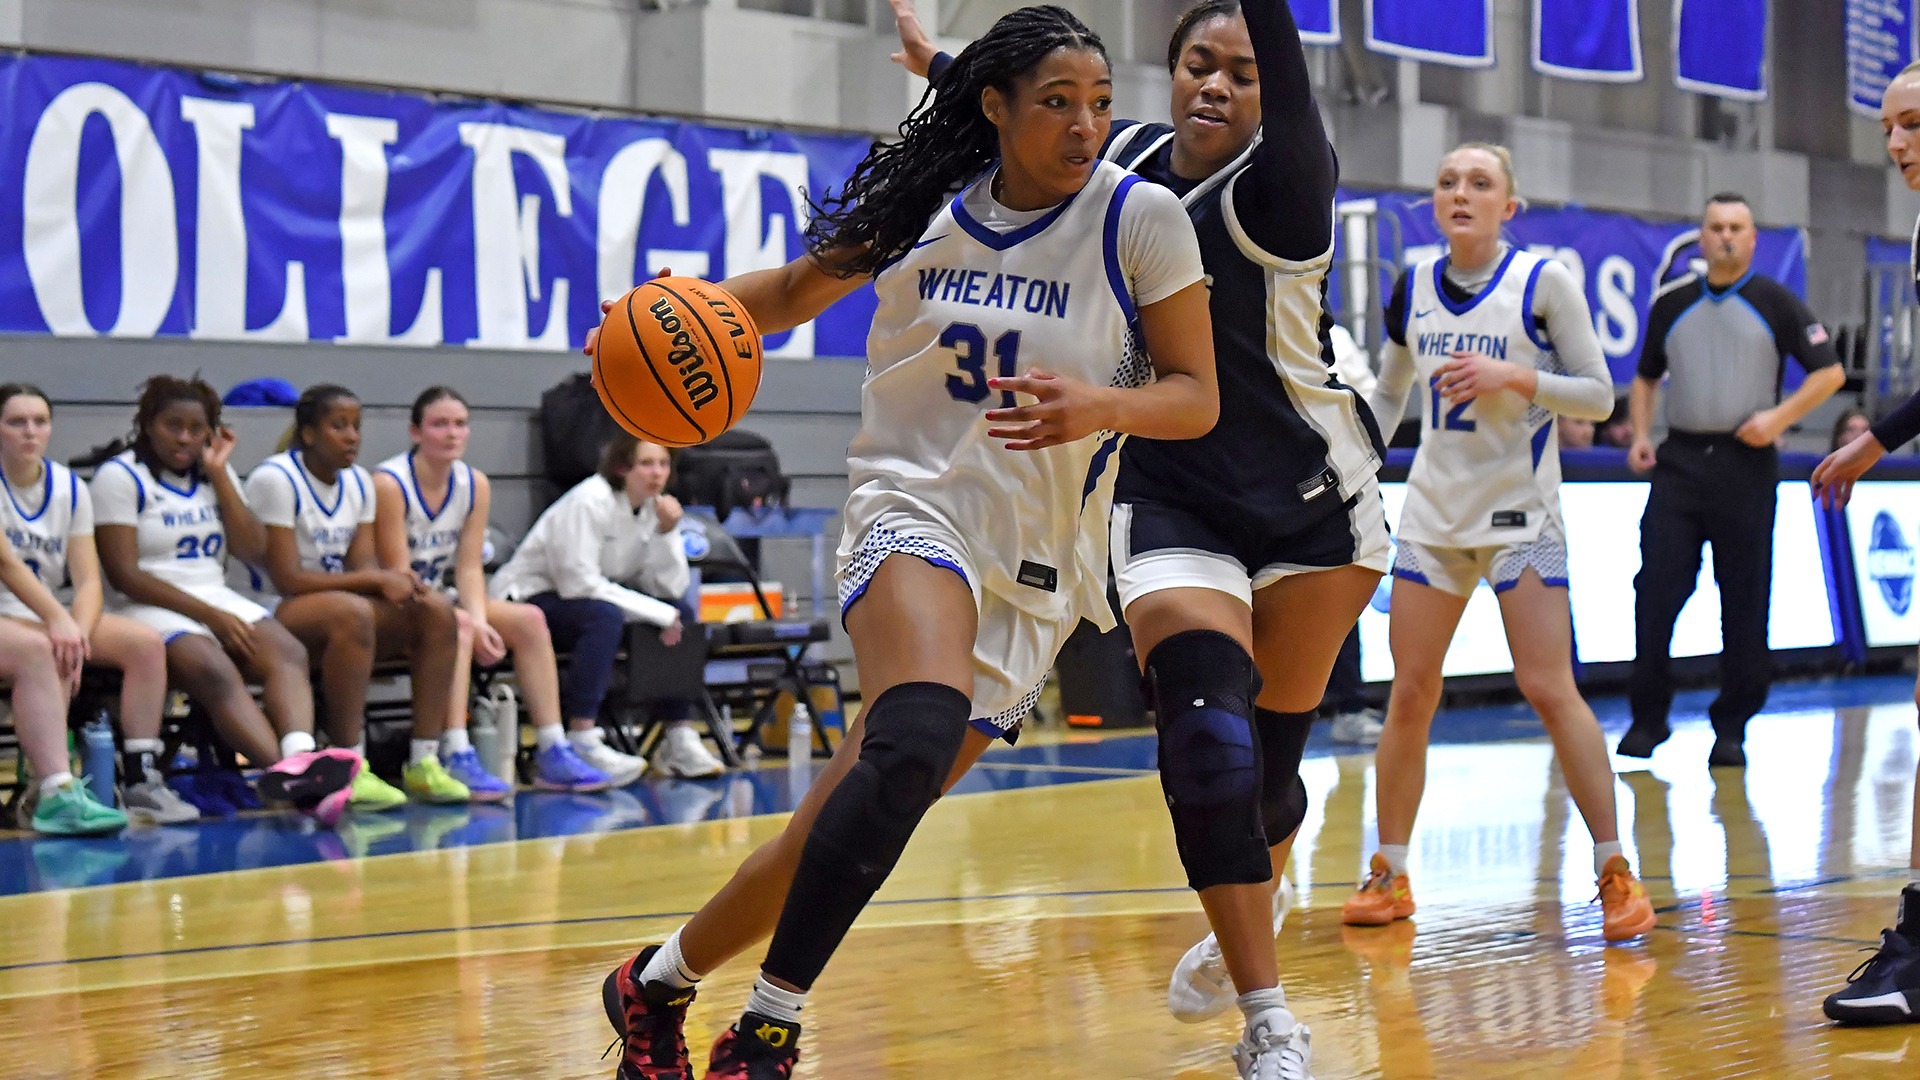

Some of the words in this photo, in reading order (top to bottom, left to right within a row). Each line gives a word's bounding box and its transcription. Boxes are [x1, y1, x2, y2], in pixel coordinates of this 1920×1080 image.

[918, 267, 1071, 319] WHEATON
[649, 296, 719, 411] Wilson
[707, 299, 753, 360] EVO
[1418, 333, 1507, 360] WHEATON
[938, 320, 1022, 408] 31
[176, 532, 222, 559] 20
